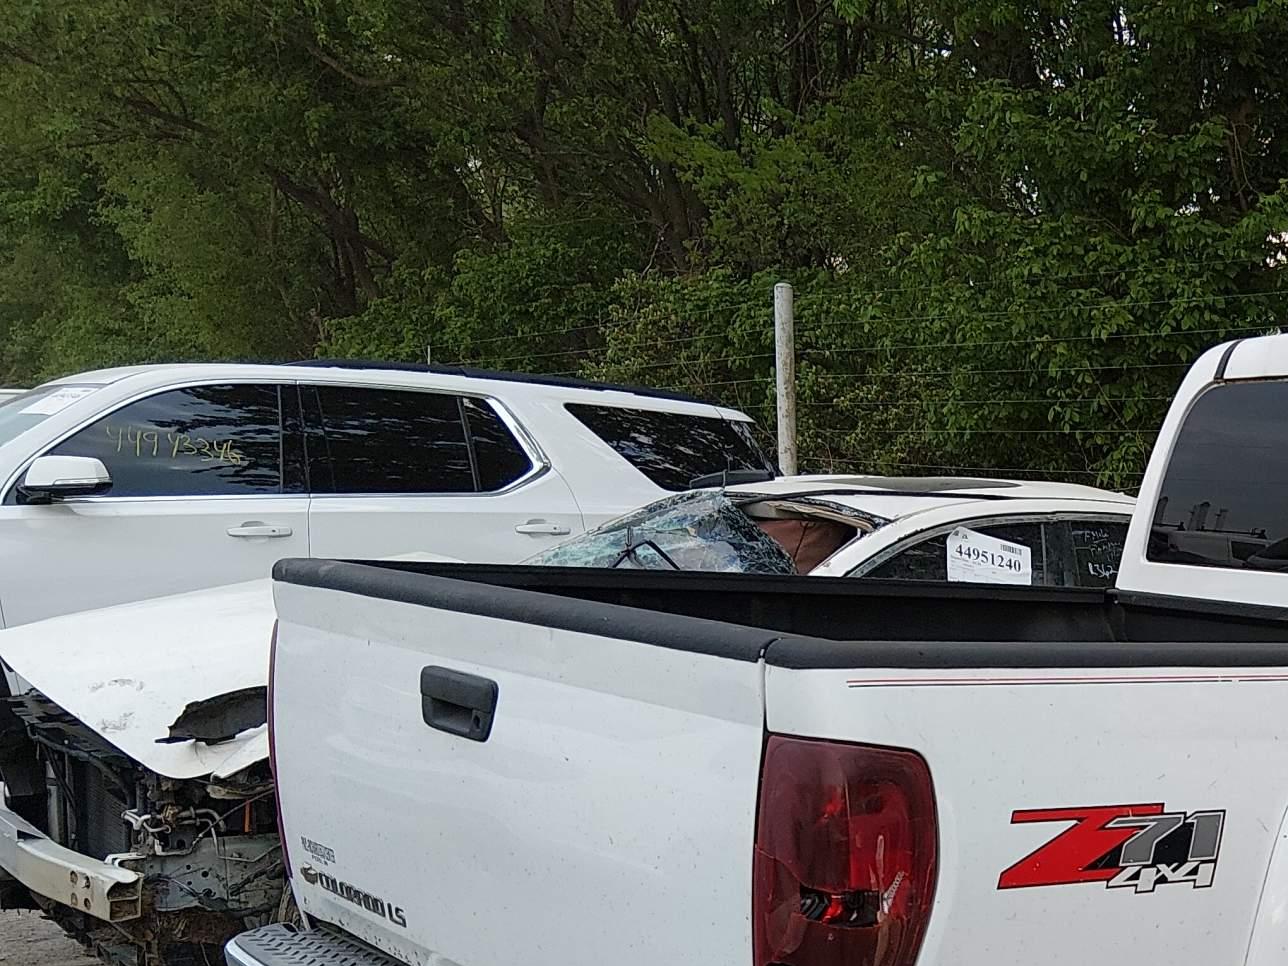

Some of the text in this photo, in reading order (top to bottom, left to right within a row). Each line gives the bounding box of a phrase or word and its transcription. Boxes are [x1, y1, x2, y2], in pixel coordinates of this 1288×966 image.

[955, 543, 1021, 573] 44951240
[997, 803, 1226, 890] Z71
[318, 872, 408, 928] COLORADO LS
